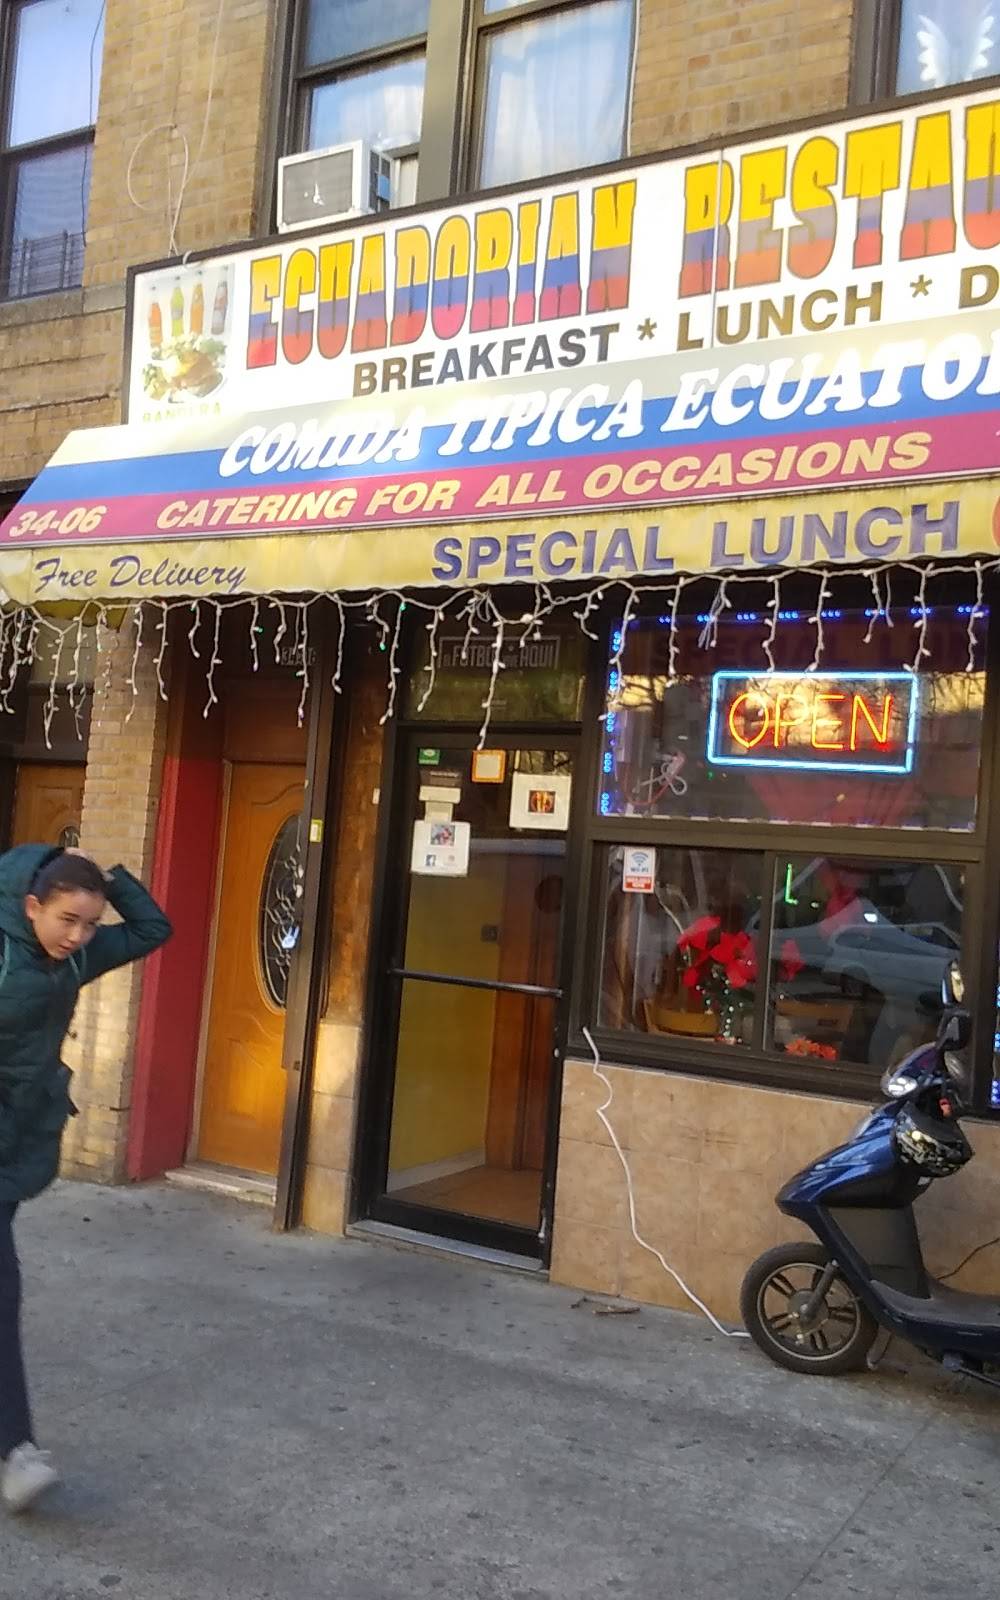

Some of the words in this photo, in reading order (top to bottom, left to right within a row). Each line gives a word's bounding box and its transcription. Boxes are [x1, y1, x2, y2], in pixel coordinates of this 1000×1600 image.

[246, 179, 638, 370] ECUADORIAN
[353, 323, 620, 398] BREAKFAST
[677, 281, 883, 352] LUNCH
[219, 405, 426, 478] COMIDA
[437, 378, 644, 456] TIPICA
[9, 505, 108, 537] 34-06
[156, 489, 353, 529] CATERING
[365, 480, 460, 515] FOR
[476, 475, 565, 508] ALL
[583, 432, 932, 500] OCCASIONS
[34, 557, 97, 593] Free
[110, 555, 246, 593] Delivery
[432, 526, 674, 581] SPECIAL
[711, 501, 960, 568] LUNCH
[728, 692, 893, 750] OPEN
